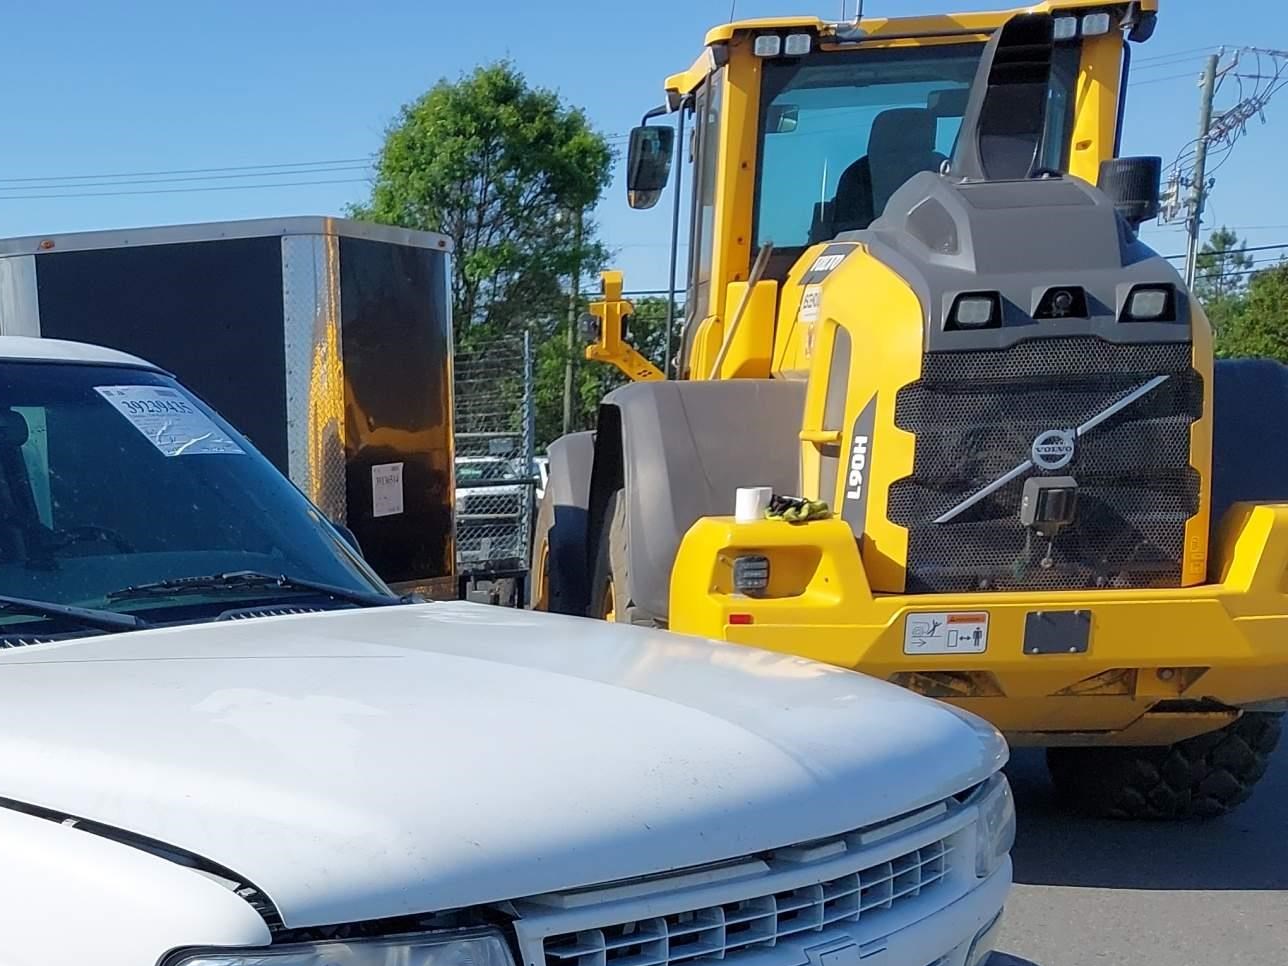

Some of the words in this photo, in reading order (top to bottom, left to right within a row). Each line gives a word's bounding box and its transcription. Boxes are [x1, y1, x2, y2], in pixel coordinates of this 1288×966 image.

[122, 400, 194, 415] 39239435
[1035, 445, 1073, 454] VOLVO
[846, 435, 869, 500] L90H
